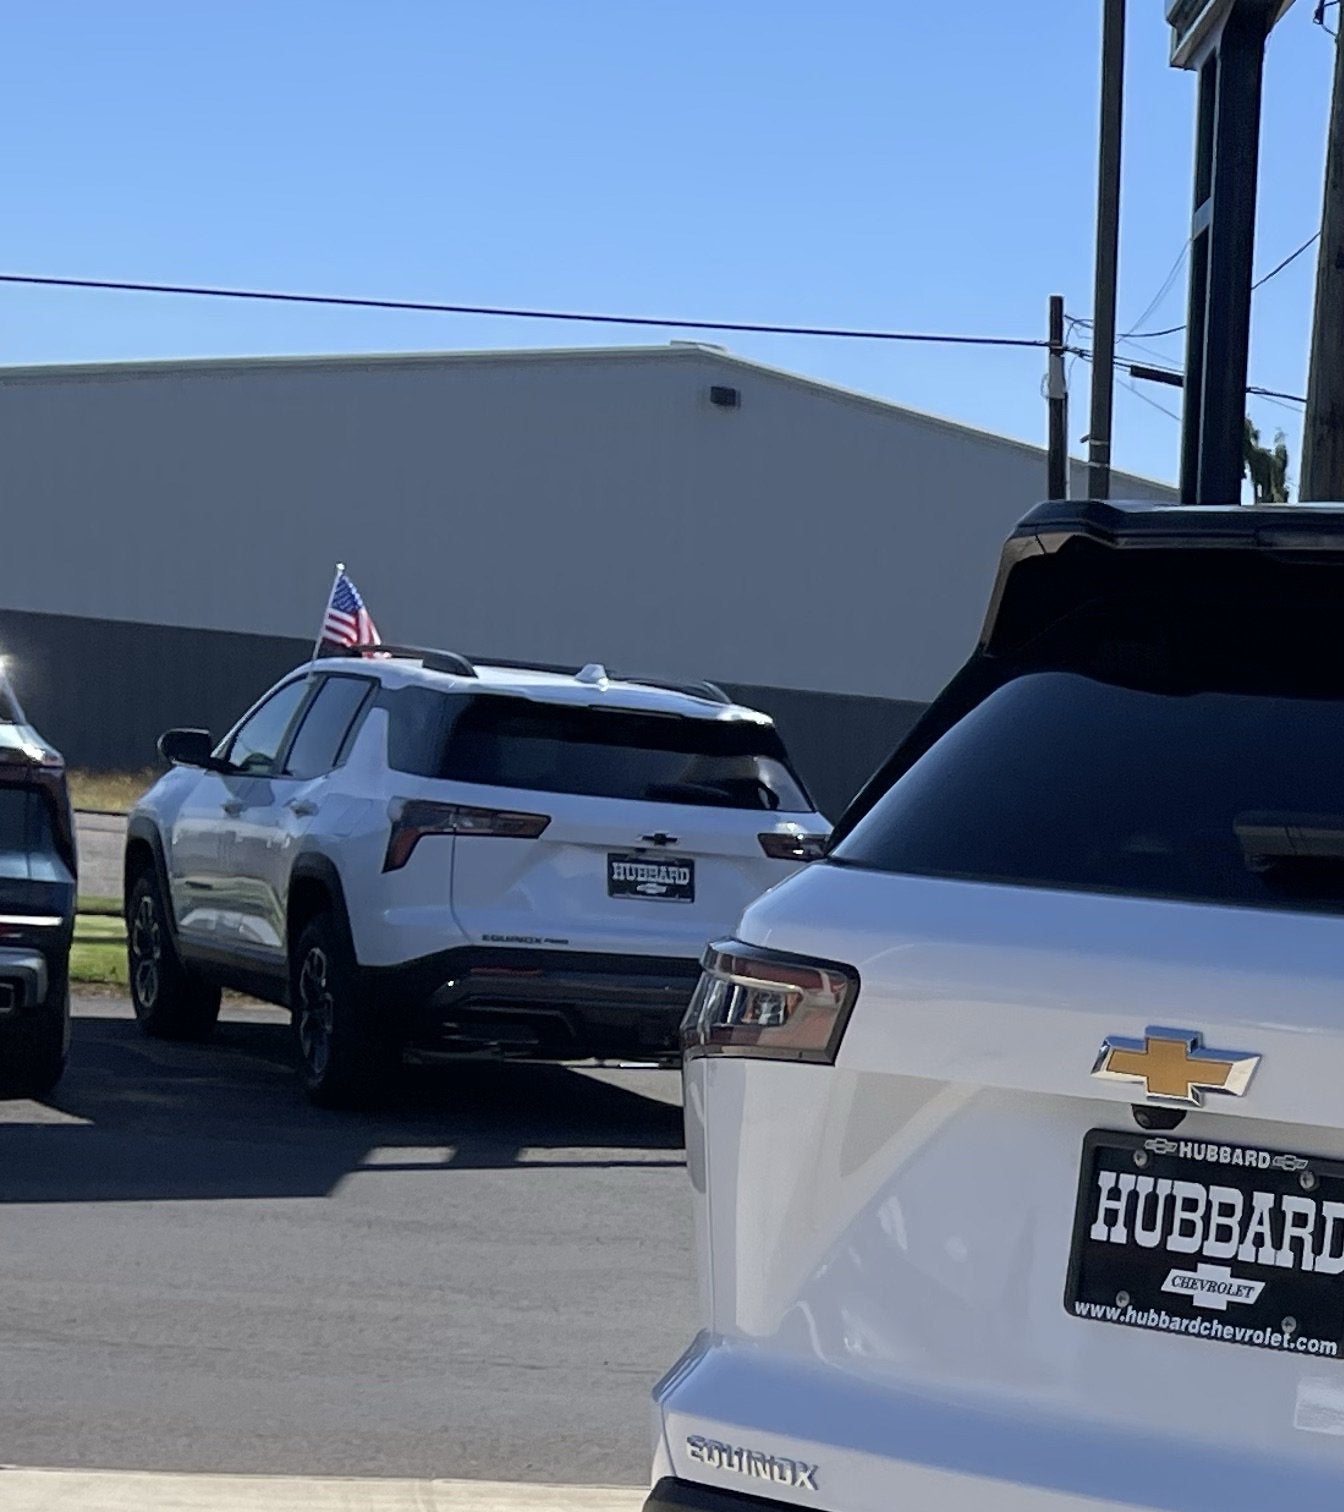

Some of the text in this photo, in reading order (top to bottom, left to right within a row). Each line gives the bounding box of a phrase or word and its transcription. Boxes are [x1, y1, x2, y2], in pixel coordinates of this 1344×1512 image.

[611, 861, 691, 886] HUBBARD
[1178, 1141, 1272, 1170] HUBBARD
[1171, 1275, 1256, 1299] CHEVROLET
[1074, 1299, 1338, 1356] www.hubbardchevrolet.com
[686, 1434, 820, 1491] EQUINOX
